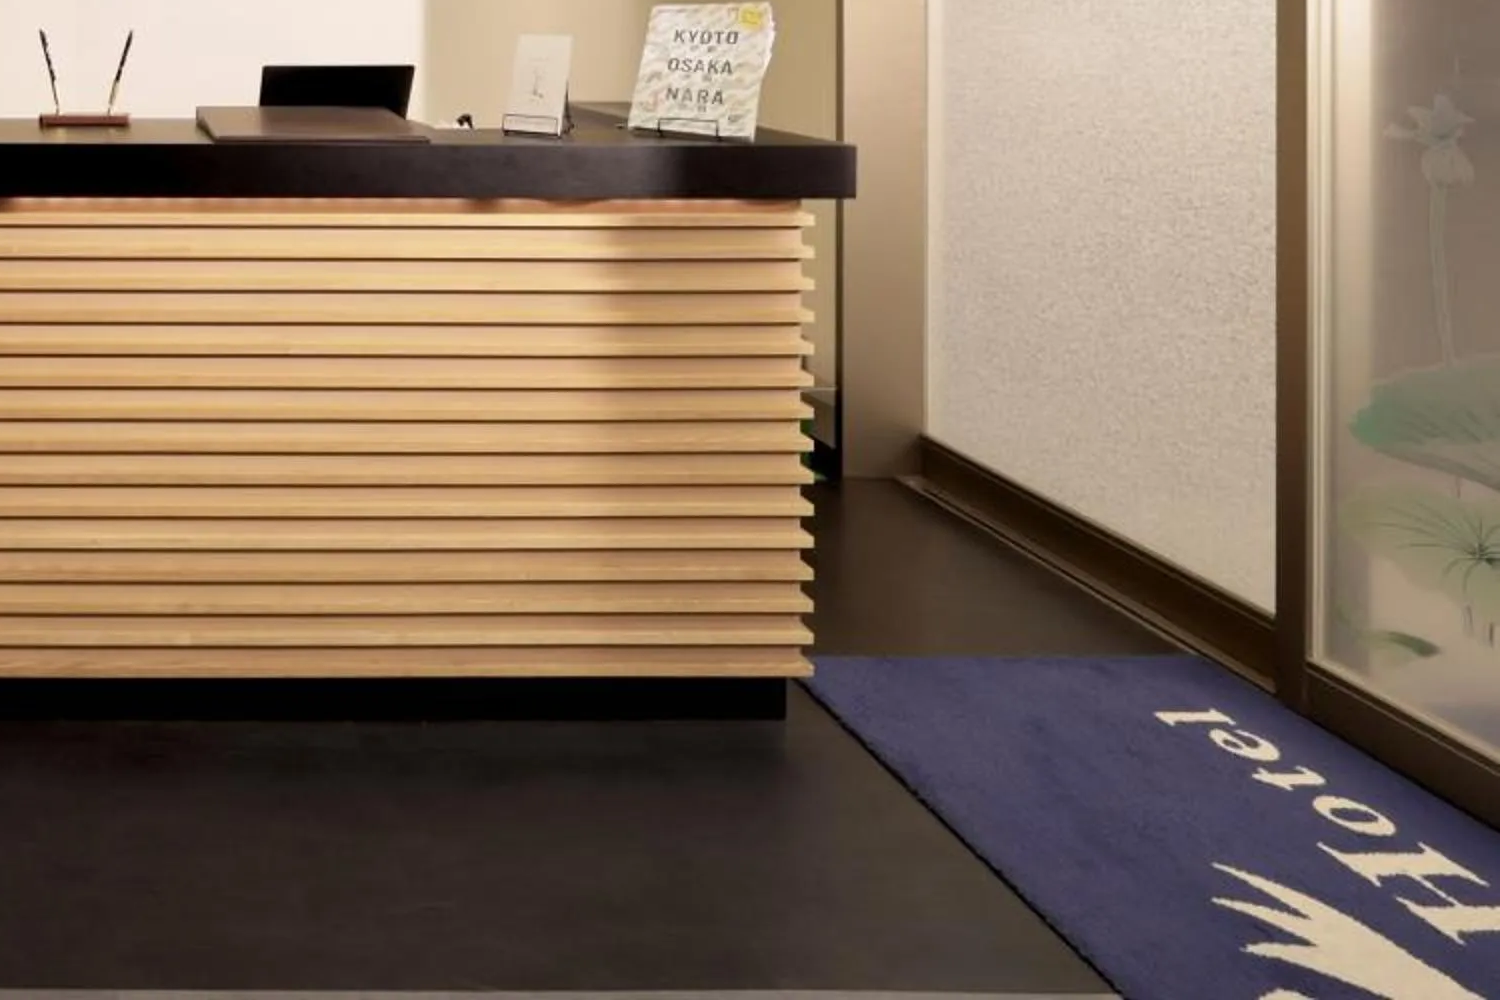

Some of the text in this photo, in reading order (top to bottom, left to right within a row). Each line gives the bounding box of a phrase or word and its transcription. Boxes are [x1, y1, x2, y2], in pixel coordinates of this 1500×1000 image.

[673, 29, 740, 45] KYOTO
[667, 57, 734, 75] OSAKA
[665, 86, 725, 106] NARA
[1153, 707, 1500, 946] Hotel
